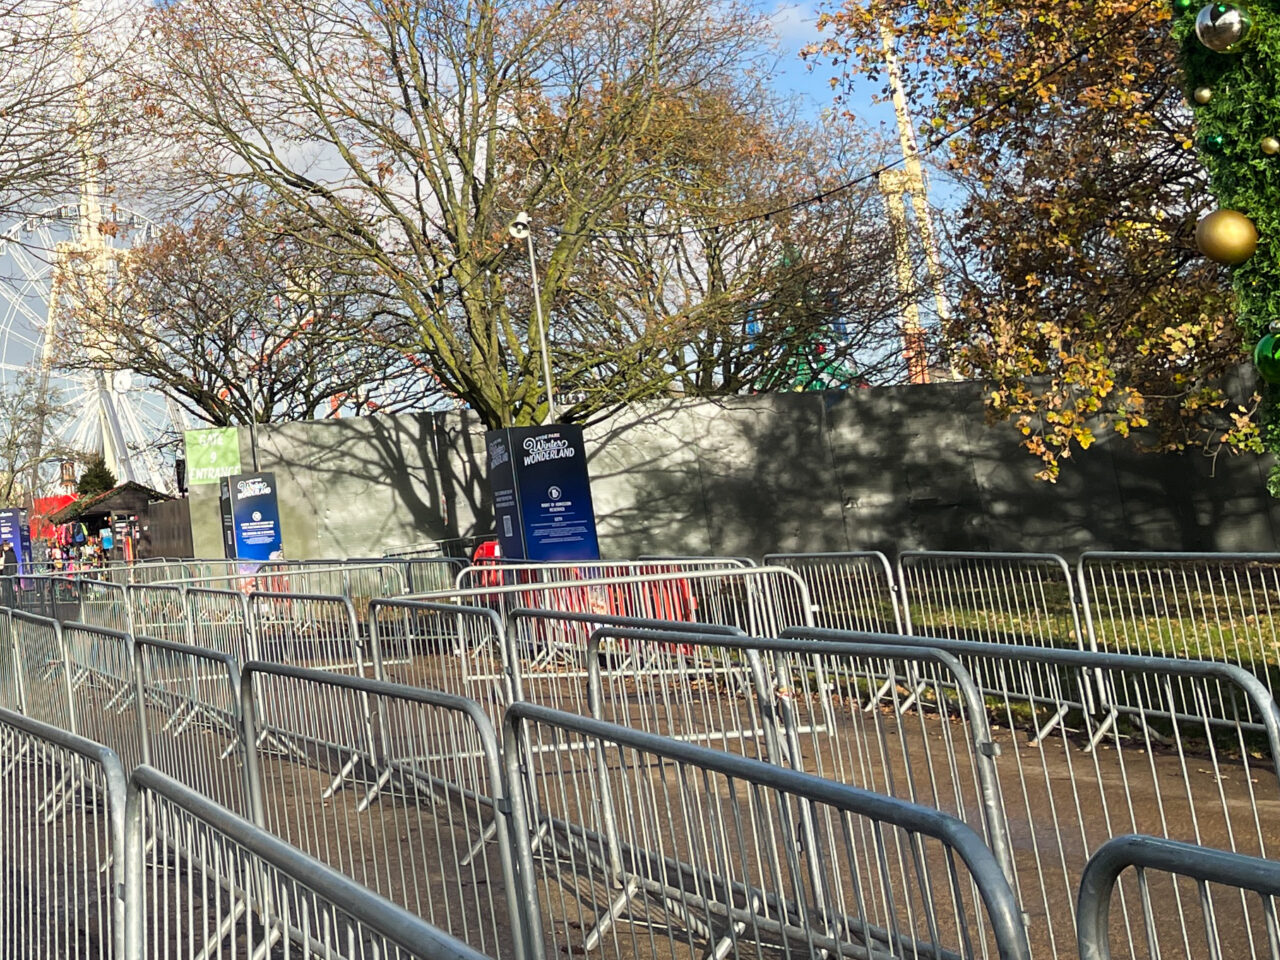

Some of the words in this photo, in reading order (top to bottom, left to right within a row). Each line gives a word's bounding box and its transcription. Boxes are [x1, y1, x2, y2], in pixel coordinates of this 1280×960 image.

[523, 437, 568, 454] Winter
[523, 447, 575, 467] WONDERLAND
[188, 465, 240, 480] ENTRANCE
